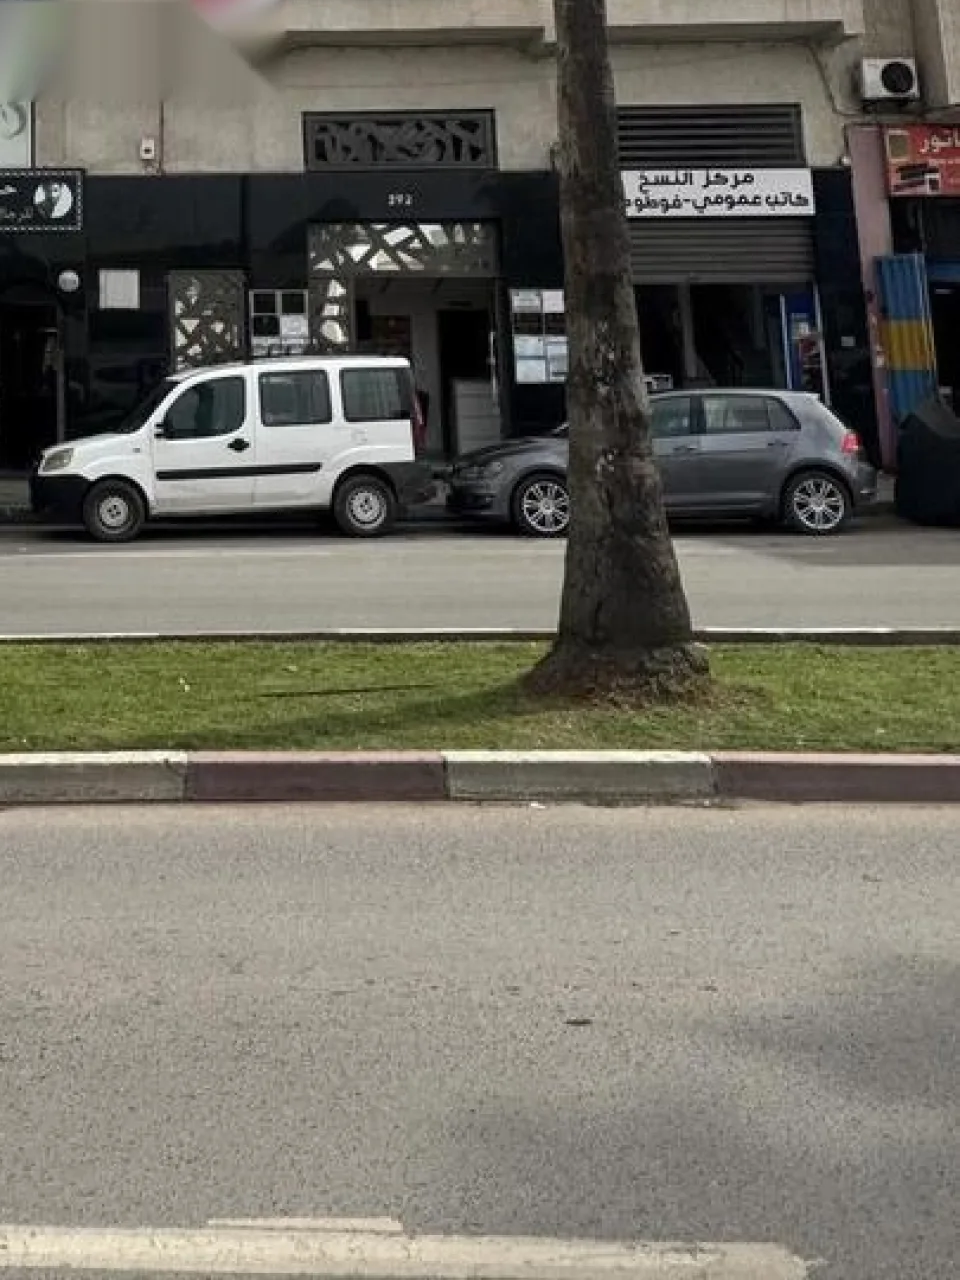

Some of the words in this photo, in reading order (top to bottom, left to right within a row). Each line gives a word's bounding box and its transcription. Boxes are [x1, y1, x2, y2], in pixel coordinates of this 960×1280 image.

[639, 170, 693, 195] النسخ
[701, 169, 755, 190] مركز
[764, 191, 810, 212] كاتب
